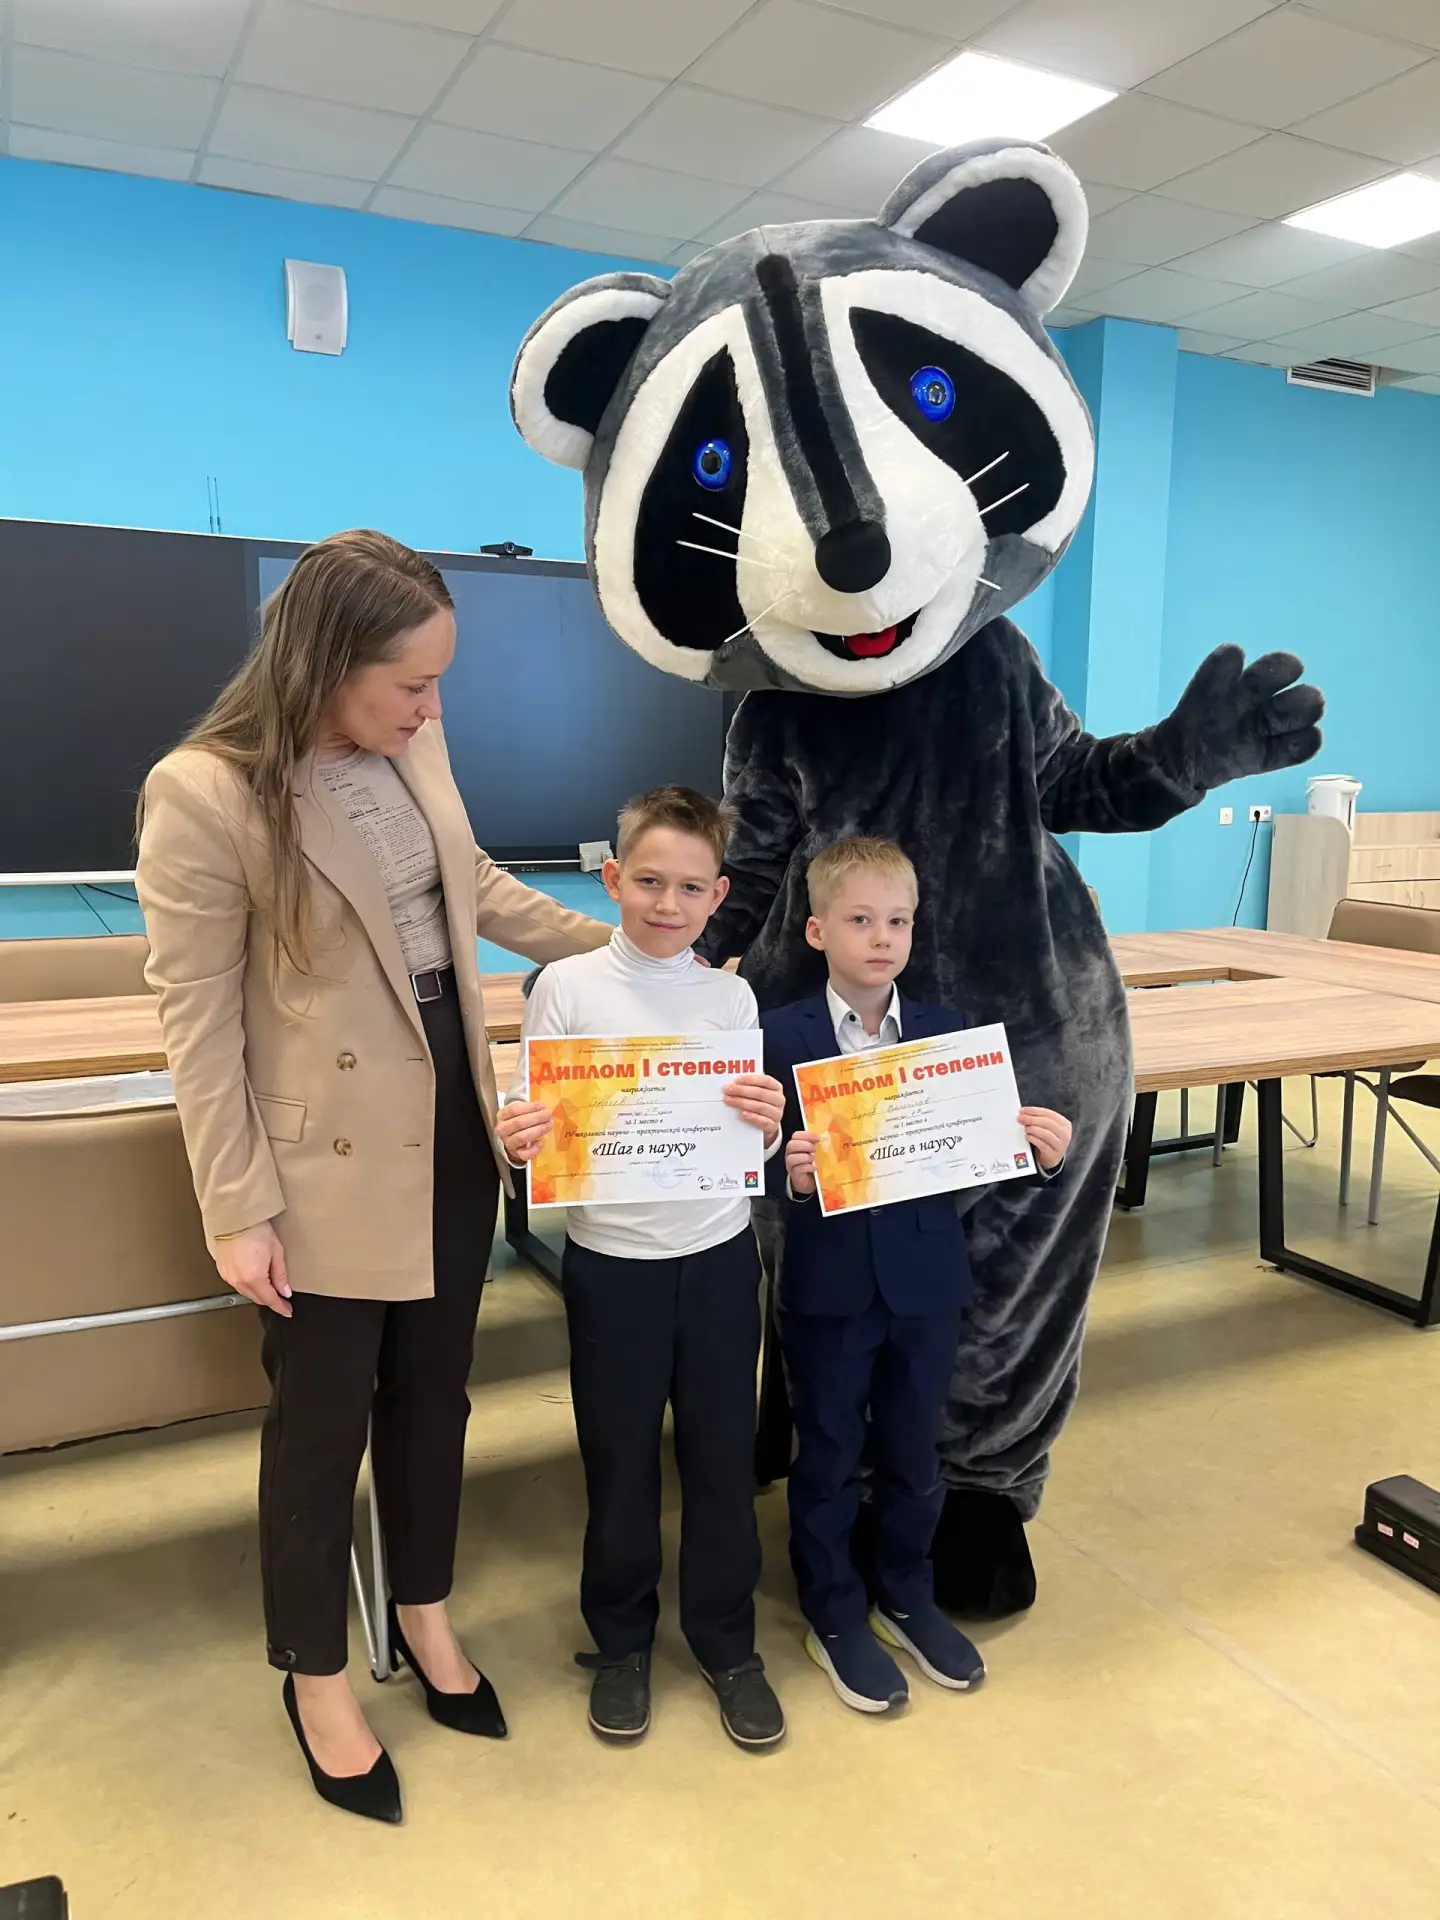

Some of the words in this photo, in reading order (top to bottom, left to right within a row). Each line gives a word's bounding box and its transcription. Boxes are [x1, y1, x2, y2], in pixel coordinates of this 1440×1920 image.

[538, 1064, 635, 1084] Диплом
[657, 1059, 756, 1076] степени
[809, 1073, 894, 1100] Диплом
[912, 1051, 1004, 1080] степени
[592, 1142, 634, 1157] «Шаг
[637, 1143, 645, 1154] в
[649, 1142, 697, 1157] науку»
[869, 1146, 905, 1161] «Шаг
[920, 1135, 963, 1152] науку»
